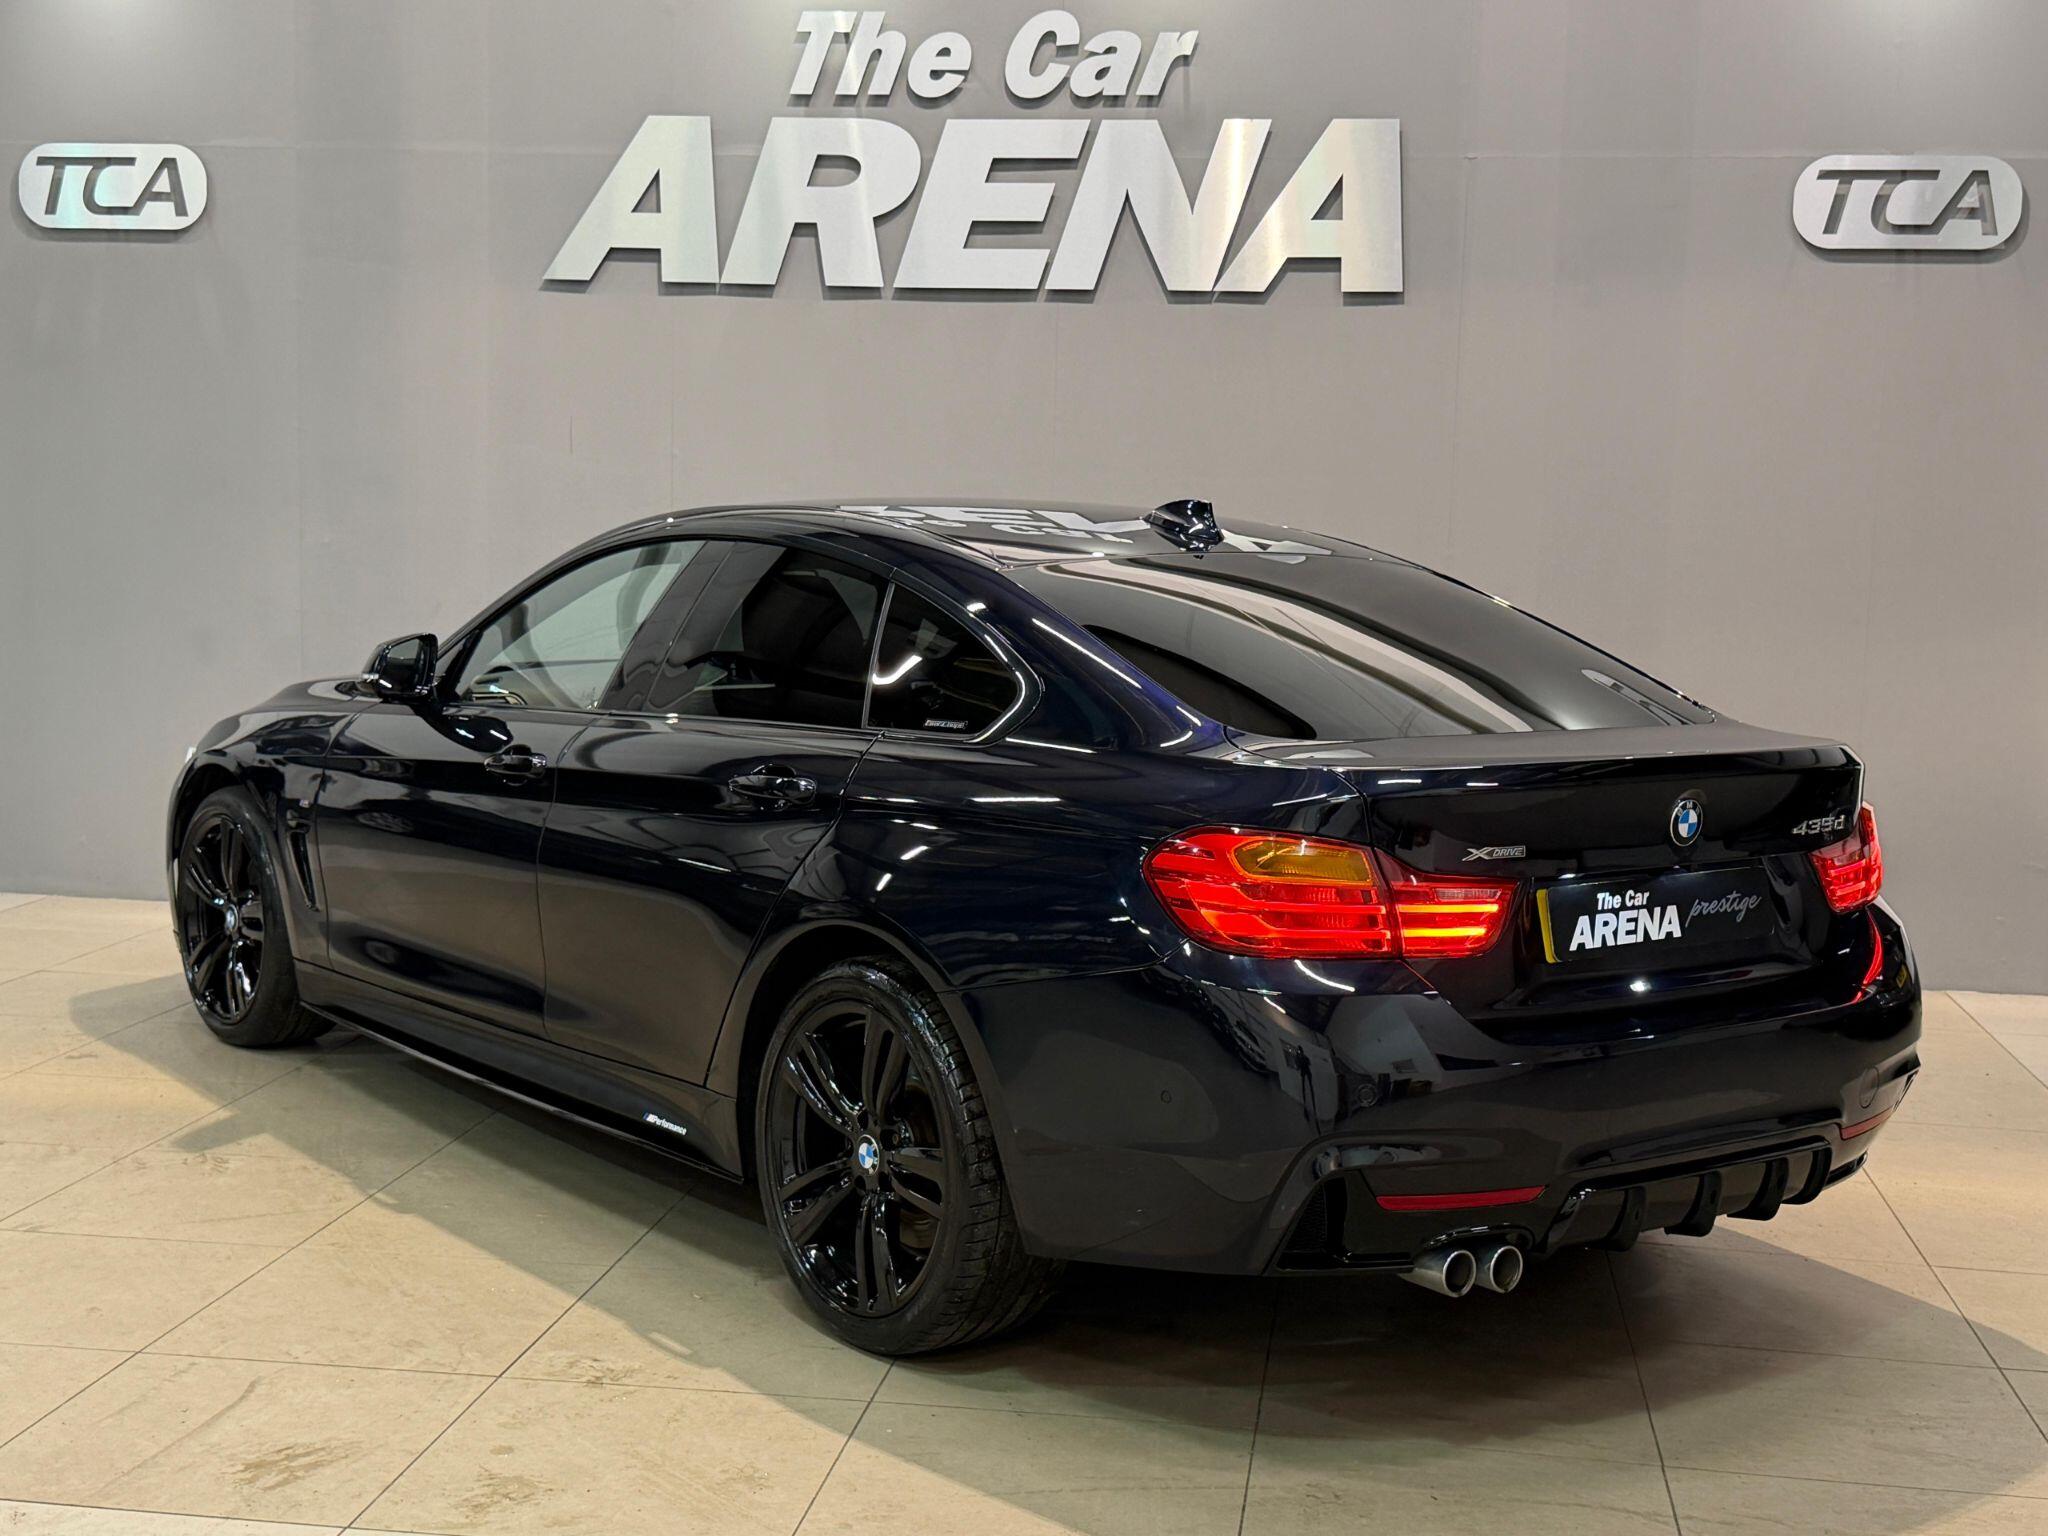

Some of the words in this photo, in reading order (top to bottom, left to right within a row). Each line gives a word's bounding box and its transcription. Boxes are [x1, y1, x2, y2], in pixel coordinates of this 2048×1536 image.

[790, 10, 972, 98] The
[1005, 9, 1199, 99] Car
[36, 156, 189, 217] TCA
[542, 115, 1402, 293] ARENA
[1816, 169, 1998, 236] TCA
[1792, 815, 1846, 836] 435d
[1597, 892, 1622, 910] The
[1625, 889, 1650, 907] Car
[1685, 890, 1762, 928] prestige
[1569, 904, 1683, 951] ARENA
